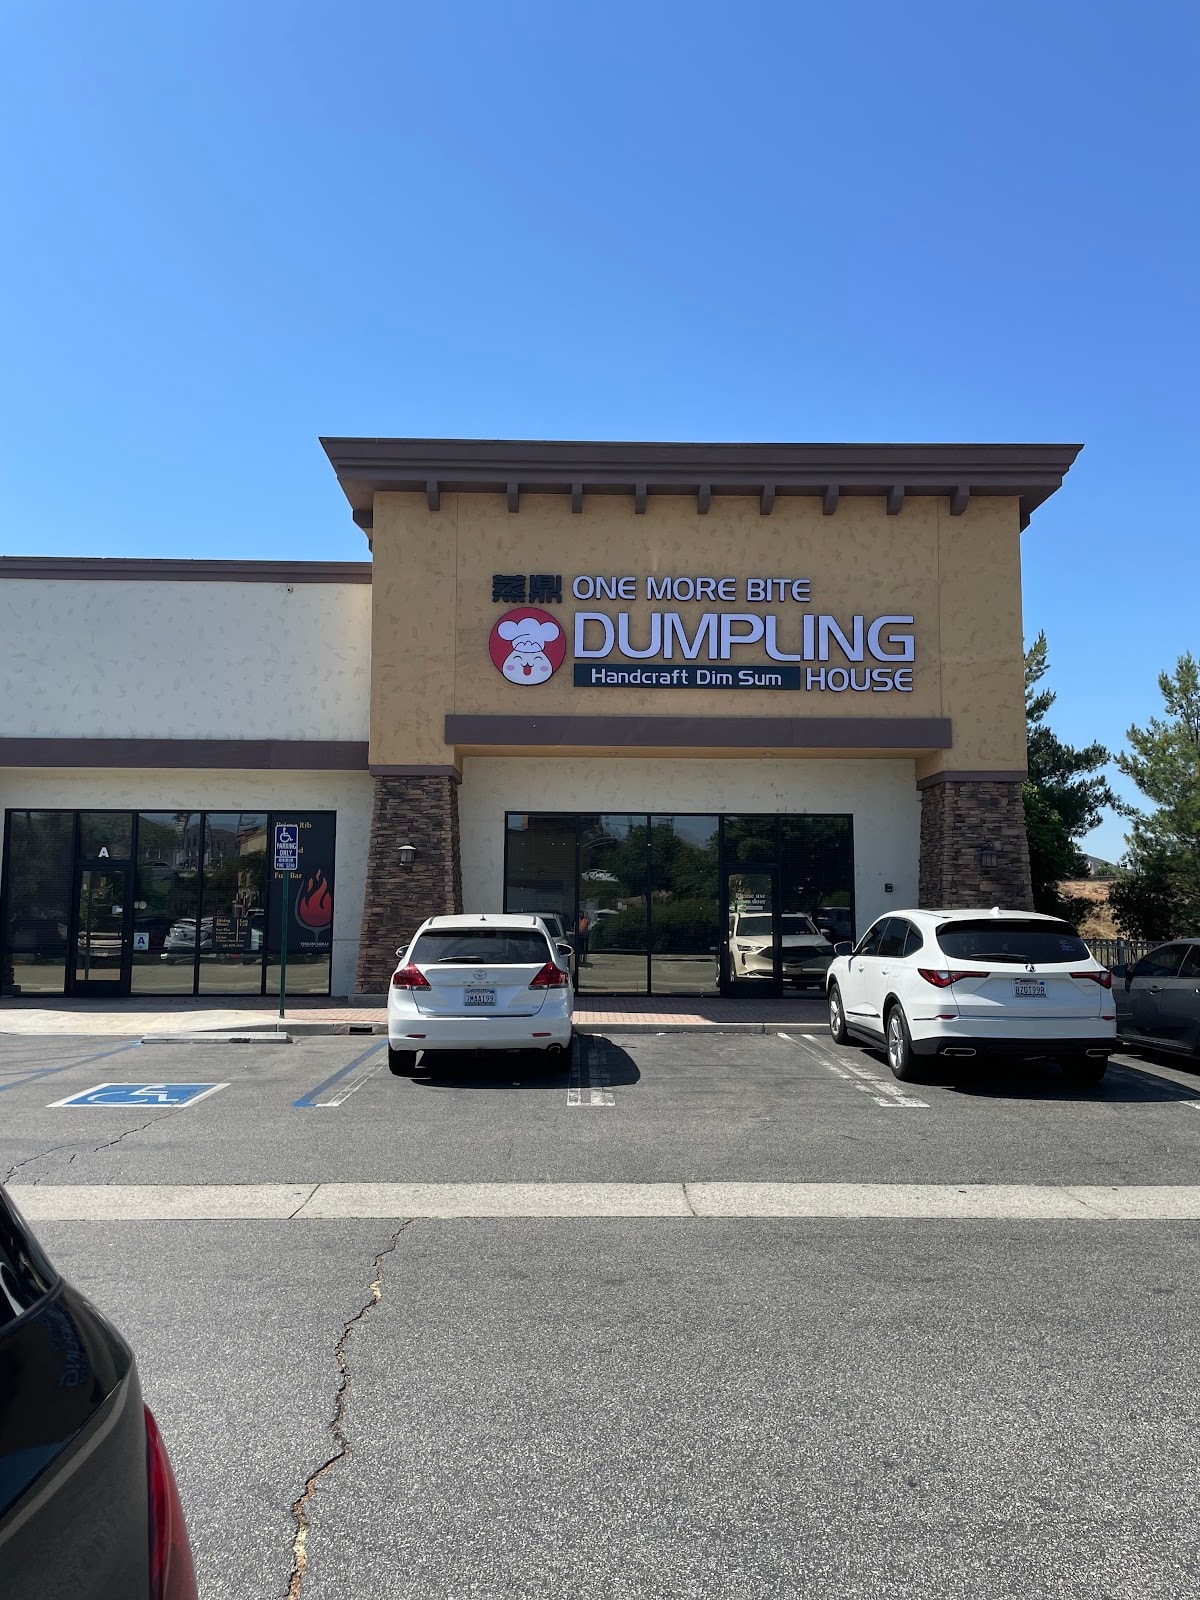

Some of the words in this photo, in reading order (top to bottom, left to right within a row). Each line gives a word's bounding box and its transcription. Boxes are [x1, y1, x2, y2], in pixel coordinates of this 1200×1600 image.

[572, 575, 637, 600] ONE
[646, 576, 737, 602] MORE
[746, 577, 811, 603] BITE
[573, 612, 915, 663] DUMPLING
[591, 668, 689, 686] Handcraft
[696, 669, 733, 686] Dim
[738, 670, 782, 687] Sum
[805, 667, 914, 692] HOUSE
[98, 847, 109, 858] A
[137, 936, 145, 945] A
